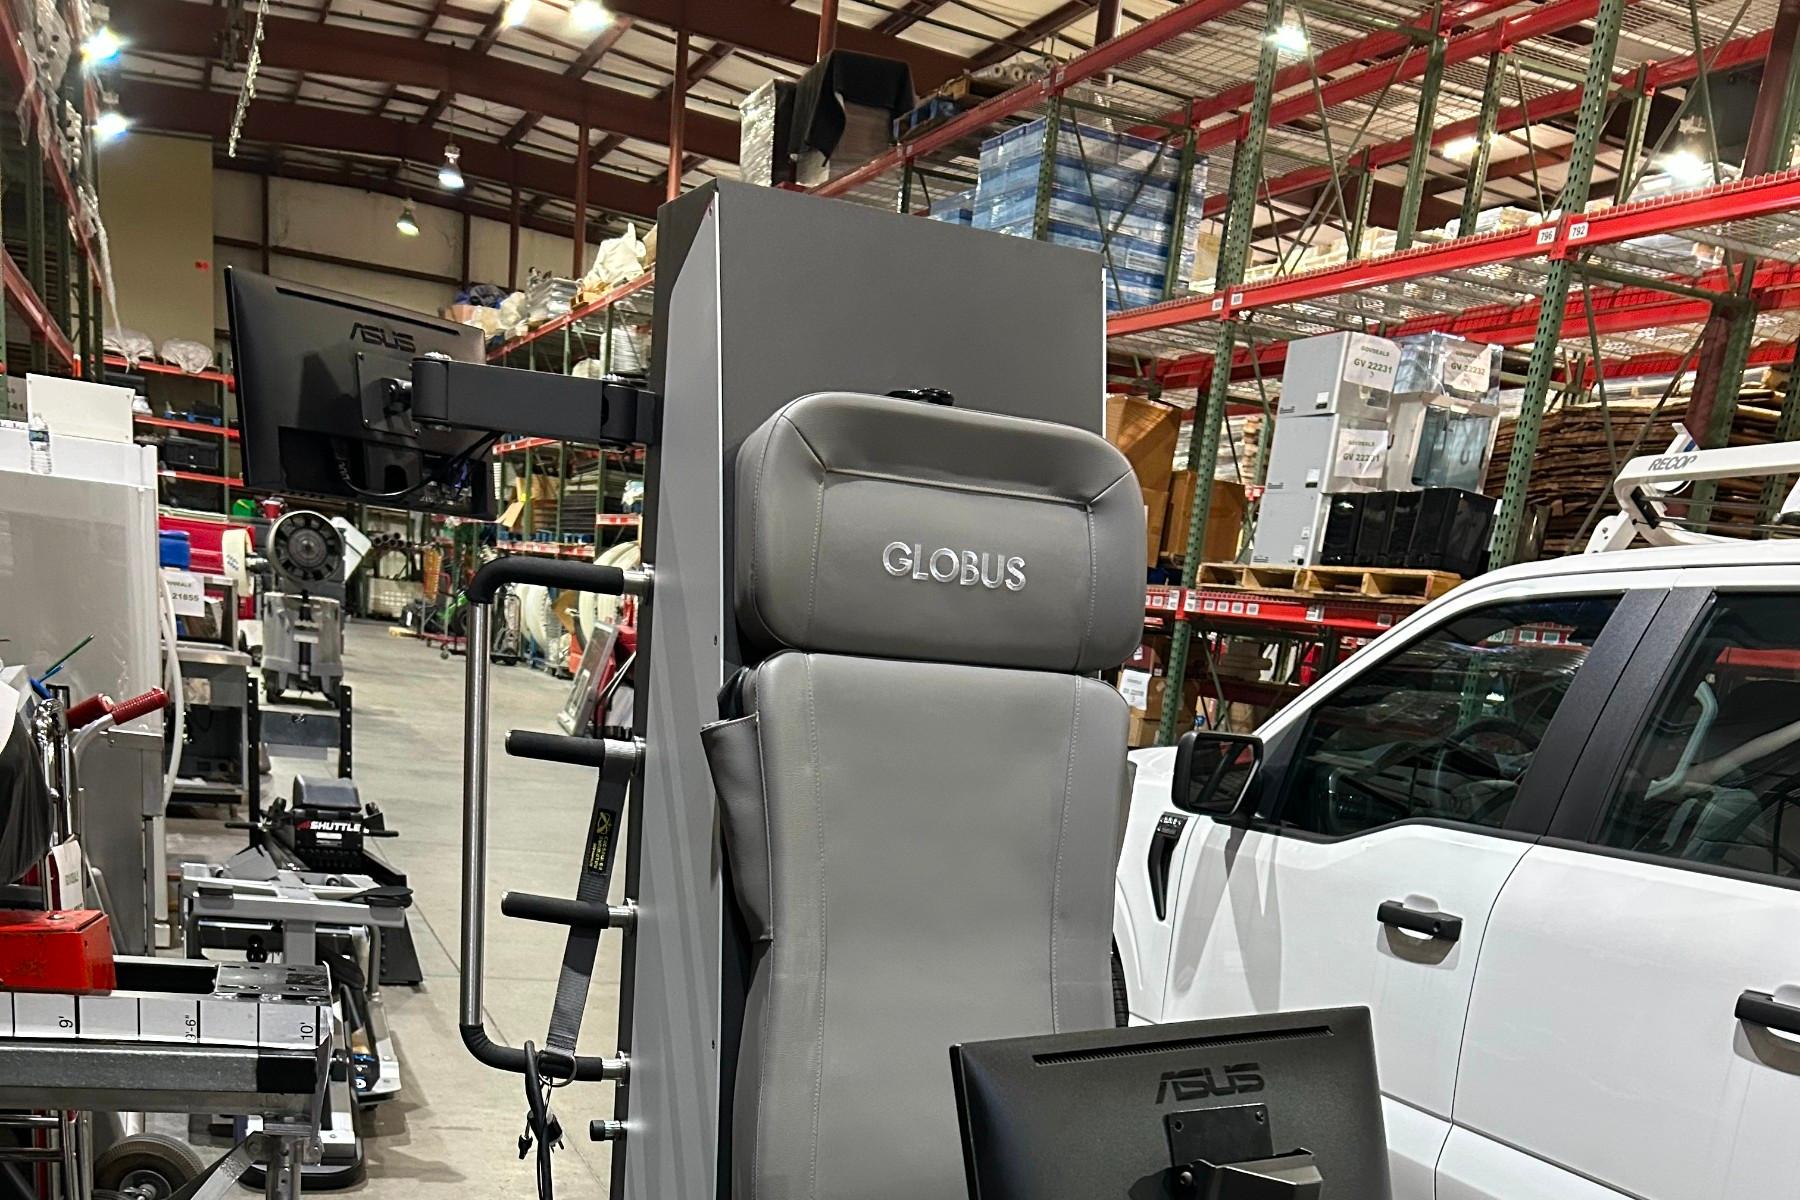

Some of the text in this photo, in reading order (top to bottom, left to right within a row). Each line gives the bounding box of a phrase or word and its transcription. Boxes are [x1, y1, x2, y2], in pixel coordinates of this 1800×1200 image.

[1540, 230, 1553, 241] 796
[1572, 225, 1586, 237] 792
[350, 322, 416, 353] ASUS
[1354, 358, 1393, 373] GV 22231
[1451, 362, 1462, 370] GV
[882, 541, 1027, 592] GLOBUS
[310, 820, 361, 832] SHUTTLE
[299, 1022, 314, 1041] 10'
[1155, 1062, 1265, 1105] ASUS
